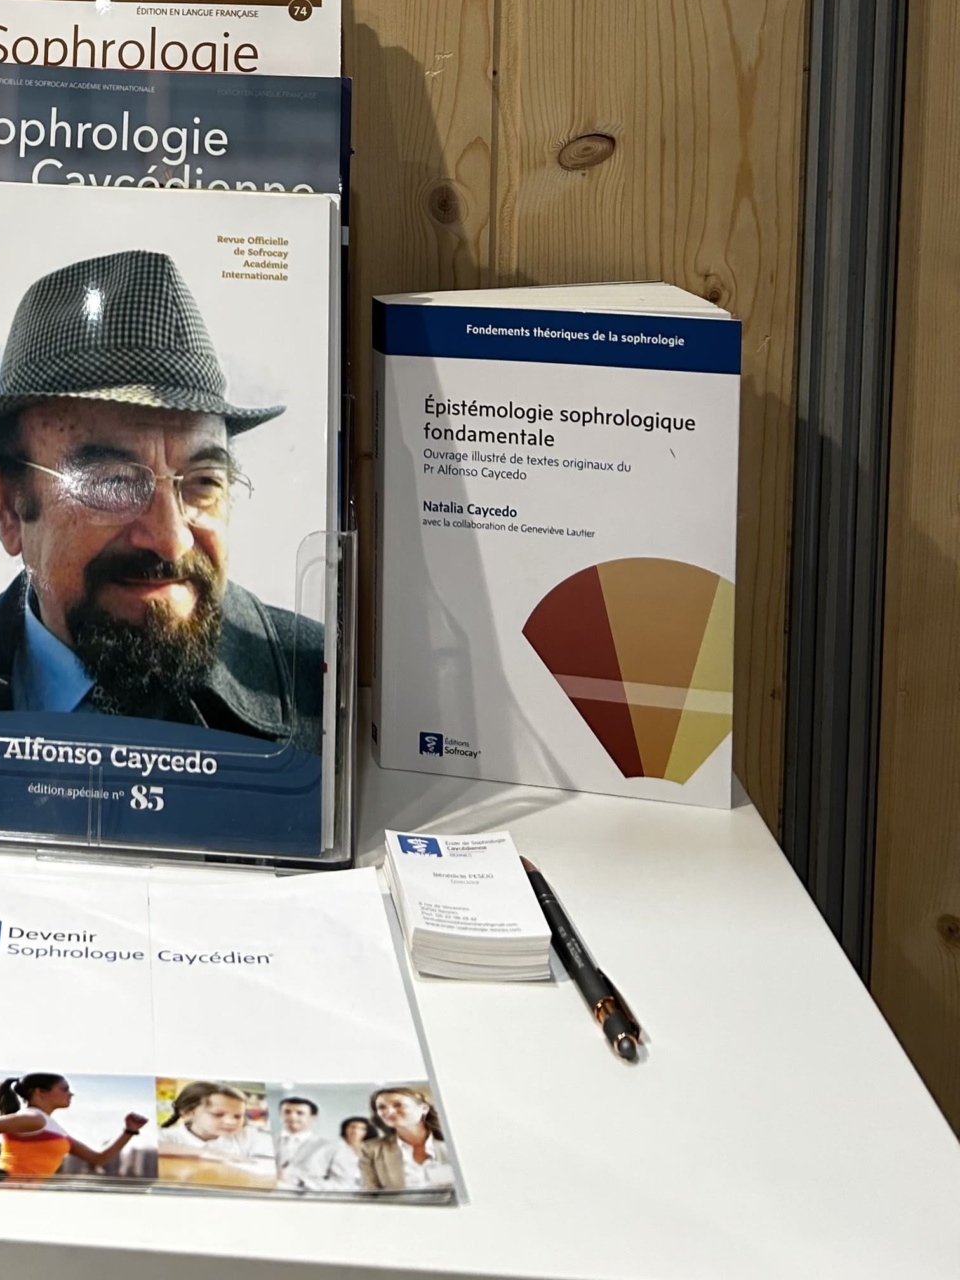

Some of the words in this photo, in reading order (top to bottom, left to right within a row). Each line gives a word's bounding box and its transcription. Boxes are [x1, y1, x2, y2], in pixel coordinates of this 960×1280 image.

[136, 6, 168, 16] ÉDITION
[169, 8, 180, 16] EN
[182, 8, 213, 17] LANGUE
[215, 9, 259, 20] FRANÇAISE
[293, 6, 308, 17] 74
[35, 80, 68, 88] SOFROCAY
[69, 81, 101, 90] ACADÉMIE
[103, 84, 155, 93] INTERNATIONALE
[217, 236, 245, 244] Revue
[248, 236, 288, 246] Officielle
[234, 247, 245, 255] de
[248, 248, 288, 260] Sofrocay
[243, 260, 288, 269] Académie
[222, 271, 288, 281] Internationale
[466, 325, 530, 337] Fondements
[533, 327, 589, 340] théoriques
[592, 331, 606, 341] de
[608, 331, 618, 342] la
[621, 333, 685, 347] sophrologie
[424, 395, 554, 423] Épistémologie
[559, 406, 696, 433] sophrologique
[424, 423, 555, 447] fondamentale
[423, 449, 469, 463] Ouvrage
[471, 450, 507, 464] illustré
[509, 453, 524, 465] de
[526, 455, 559, 467] textes
[562, 457, 613, 471] originaux
[616, 461, 631, 473] du
[423, 464, 435, 474] Pr
[437, 464, 478, 477] Alfonso
[481, 467, 527, 481] Caycedo
[423, 501, 464, 514] Natalia
[467, 504, 517, 518] Caycedo
[422, 519, 442, 527] avec
[443, 519, 451, 527] la
[452, 519, 506, 531] collaboration
[508, 522, 519, 531] de
[520, 524, 564, 536] Geneviève
[4, 737, 101, 765] Alfonso
[110, 746, 217, 776] Caycedo
[28, 783, 64, 796] édition
[67, 785, 109, 800] spéciale
[130, 785, 164, 811] 85
[8, 926, 97, 943] Devenir
[7, 943, 145, 962] Sophrologue
